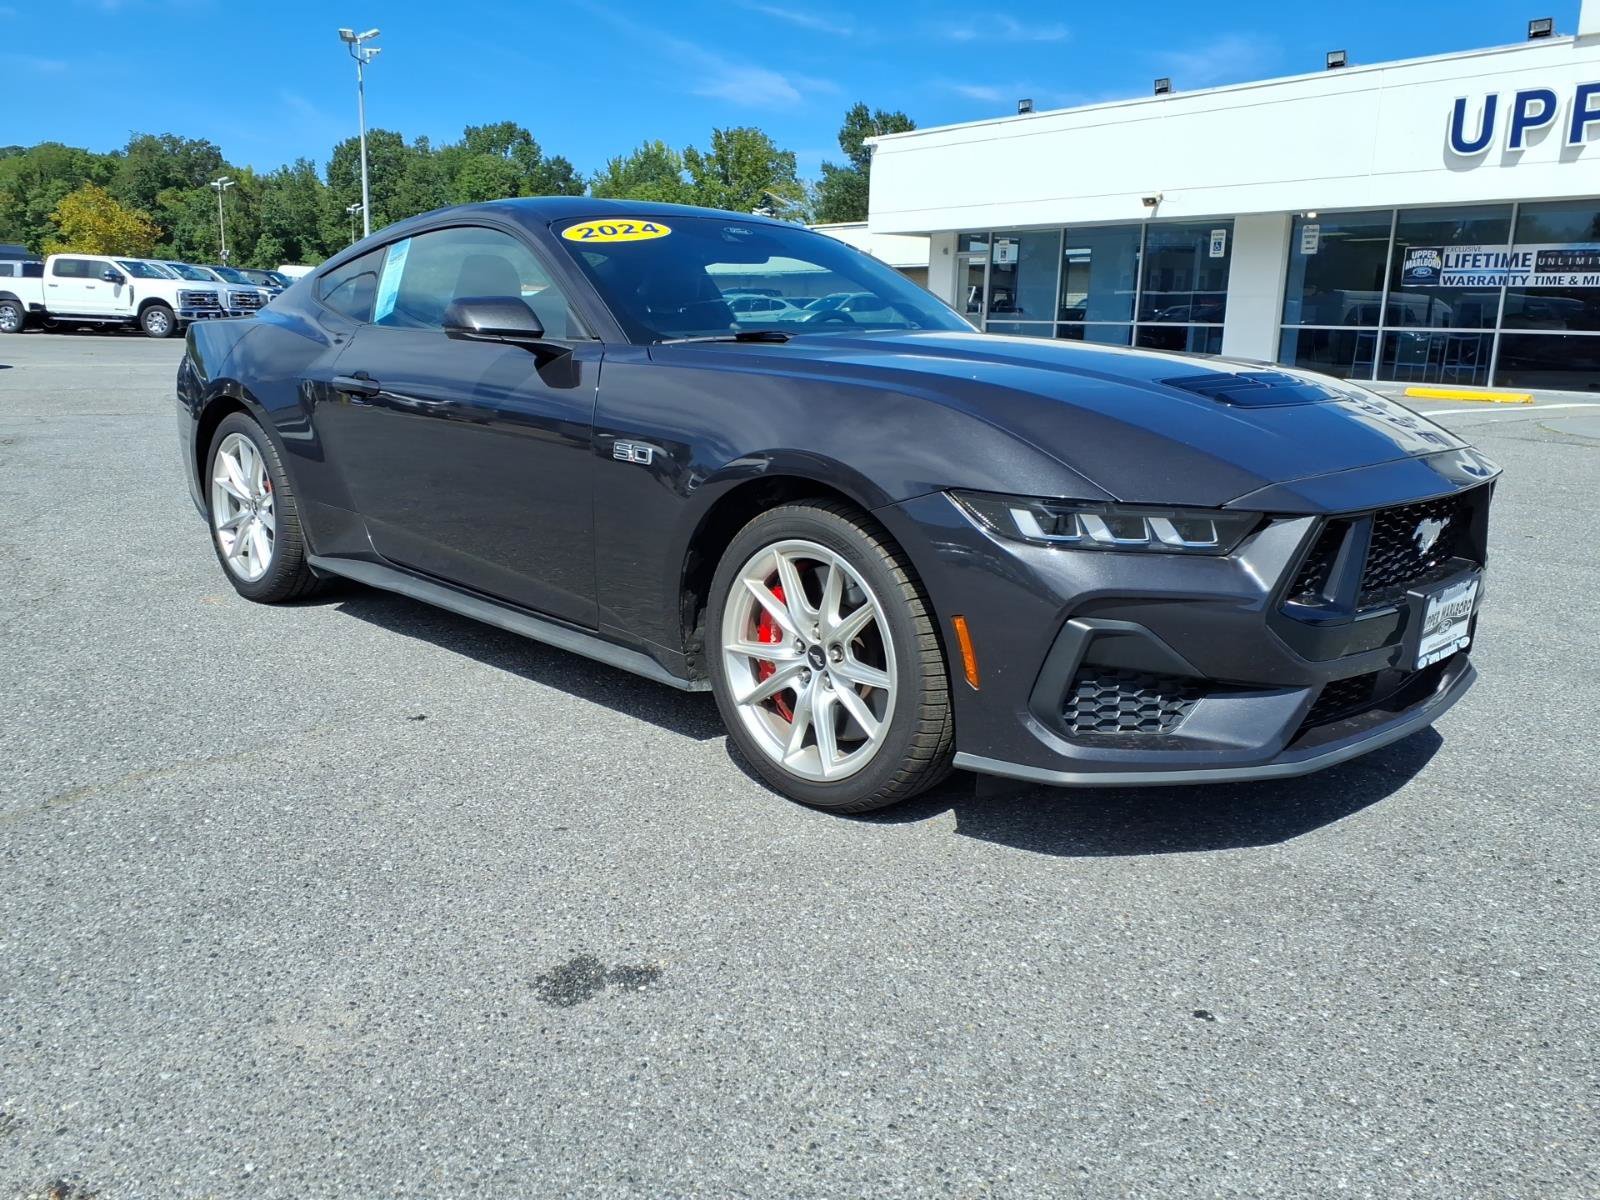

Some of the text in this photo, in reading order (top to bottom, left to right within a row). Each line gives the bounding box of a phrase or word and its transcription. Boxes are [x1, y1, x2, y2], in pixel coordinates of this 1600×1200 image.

[577, 223, 660, 239] 2024
[1411, 250, 1438, 259] UPPER
[1405, 258, 1441, 270] MARLBORO
[1444, 252, 1533, 269] LIFETIME
[1442, 275, 1530, 286] WARRANTY
[1534, 275, 1566, 286] TIME
[1568, 275, 1578, 286] &
